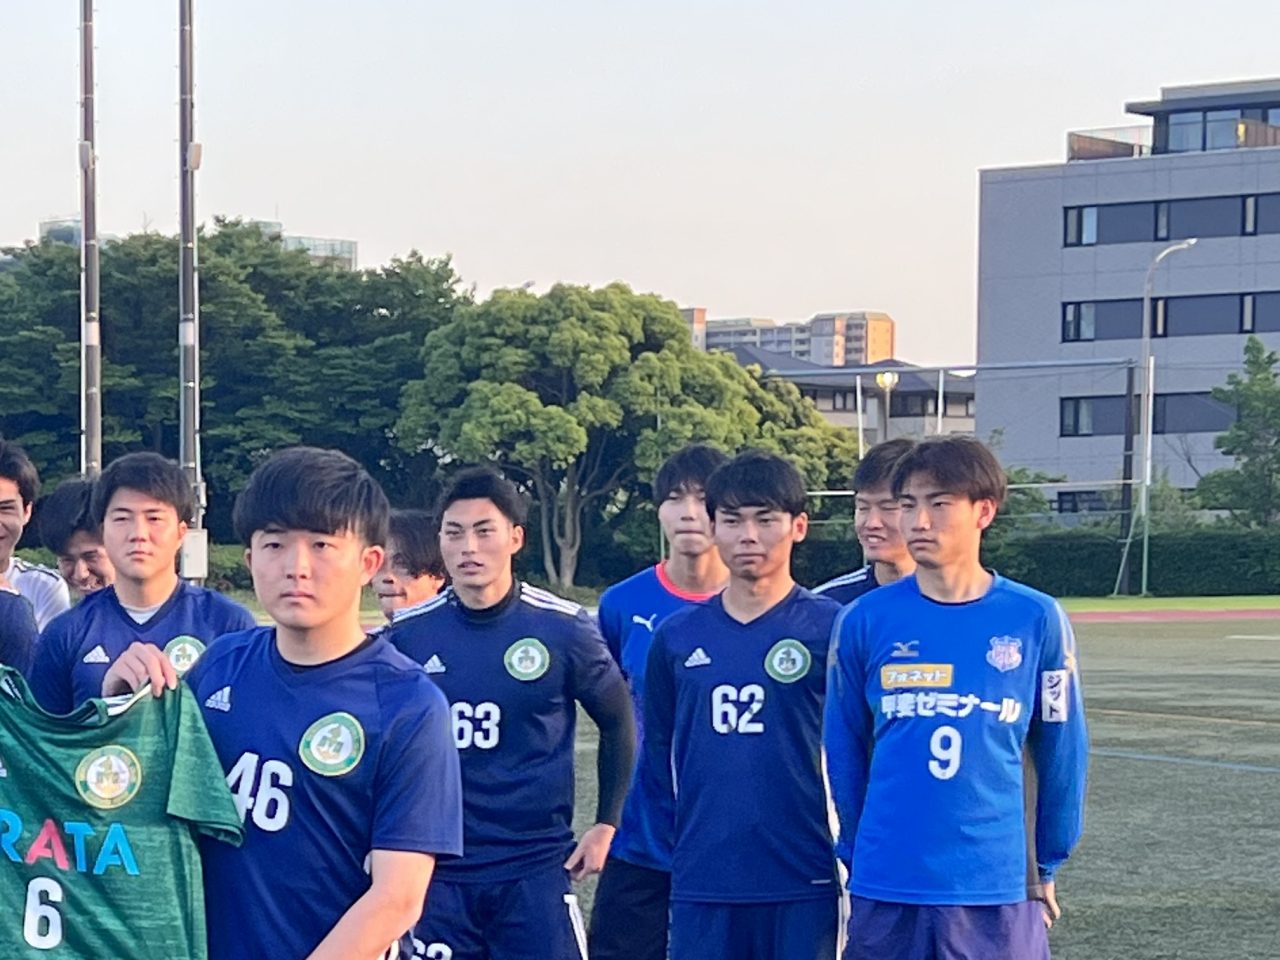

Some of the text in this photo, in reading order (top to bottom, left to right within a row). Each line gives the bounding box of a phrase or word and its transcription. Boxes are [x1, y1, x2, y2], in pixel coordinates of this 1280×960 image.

[711, 684, 765, 734] 62
[1047, 674, 1063, 719] ジット
[450, 702, 501, 749] 63
[928, 725, 962, 780] 9
[225, 751, 294, 832] 46
[23, 877, 62, 949] 6
